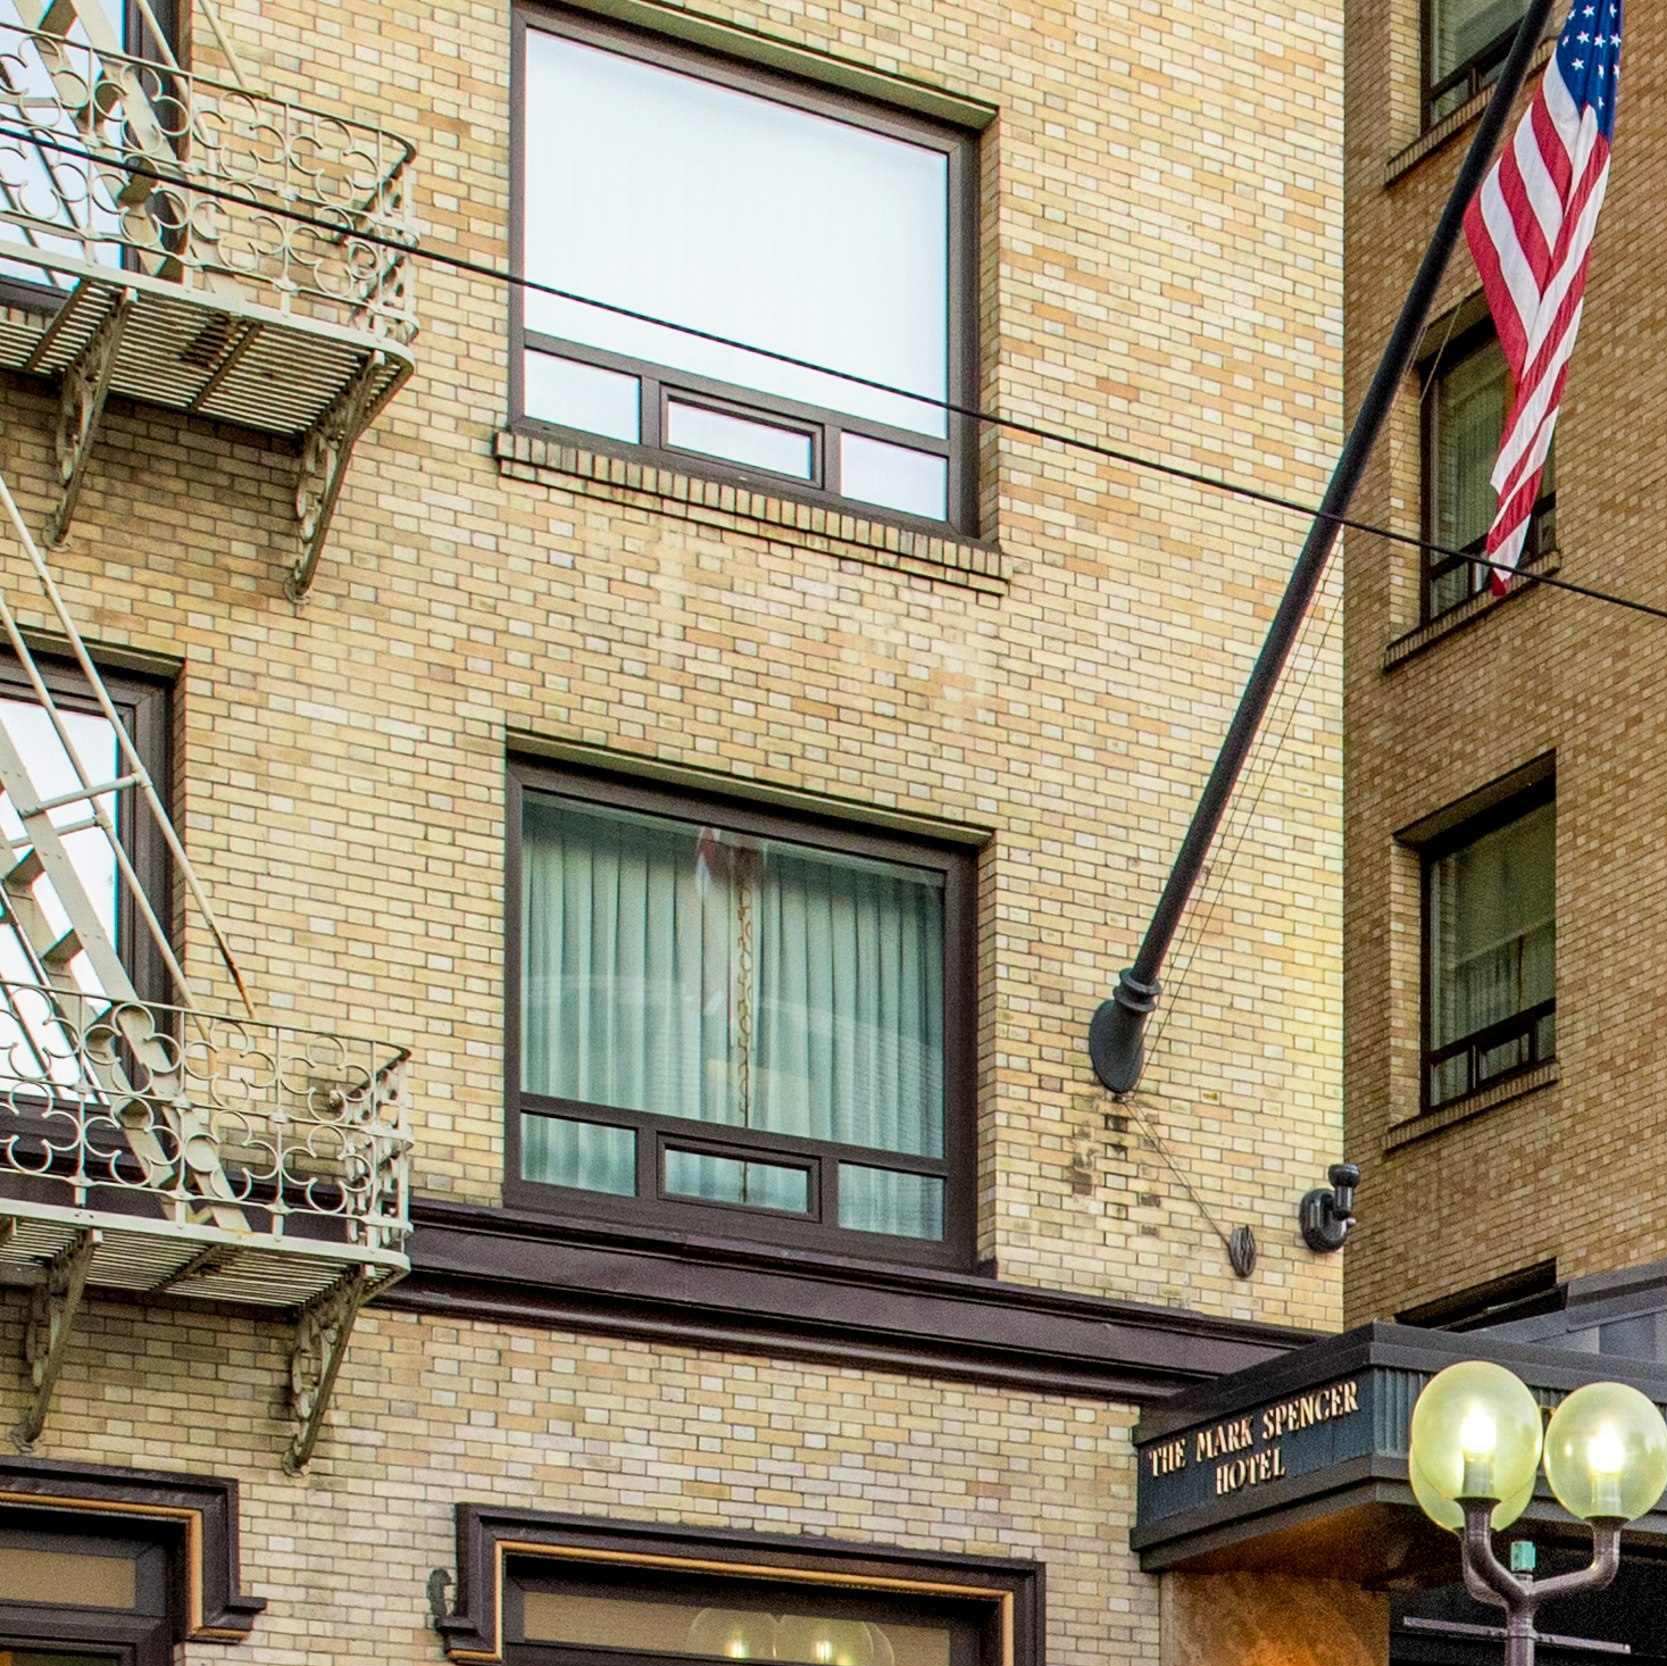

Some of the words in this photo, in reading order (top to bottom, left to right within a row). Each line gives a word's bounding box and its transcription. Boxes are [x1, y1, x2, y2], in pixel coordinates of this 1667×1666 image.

[1149, 1438, 1187, 1477] THE
[1196, 1416, 1254, 1463] MARK
[1262, 1380, 1360, 1440] SPENCER
[1215, 1446, 1286, 1496] HOTEL
